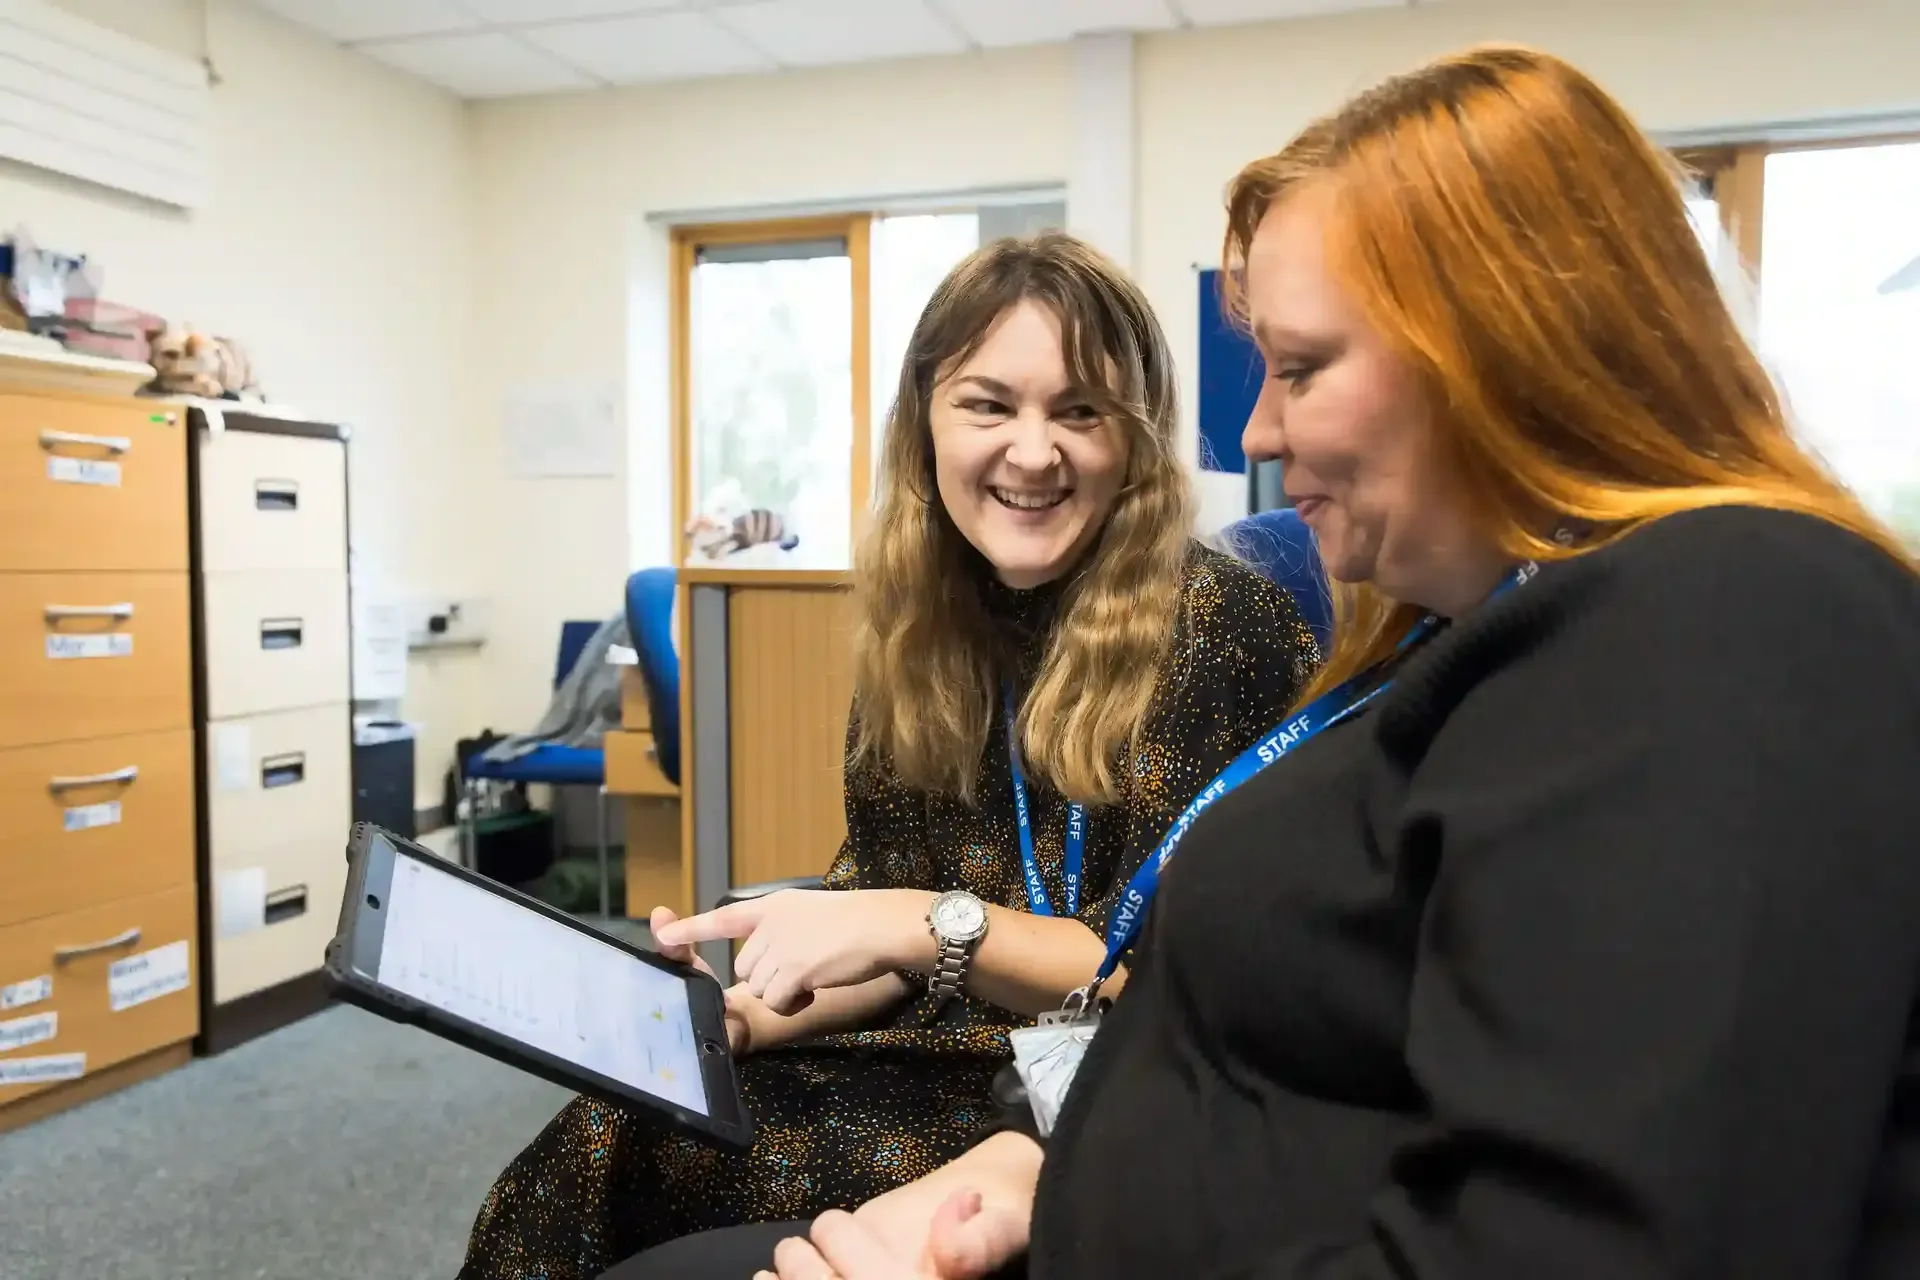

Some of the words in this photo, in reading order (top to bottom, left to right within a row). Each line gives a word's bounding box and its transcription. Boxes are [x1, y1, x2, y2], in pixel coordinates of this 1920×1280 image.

[1257, 715, 1311, 763] STAFF
[1015, 782, 1027, 827] STAFF
[1070, 804, 1083, 841] TAFF
[1025, 858, 1044, 905] STAFF
[1067, 874, 1077, 915] STAF
[1113, 889, 1143, 941] STAFF
